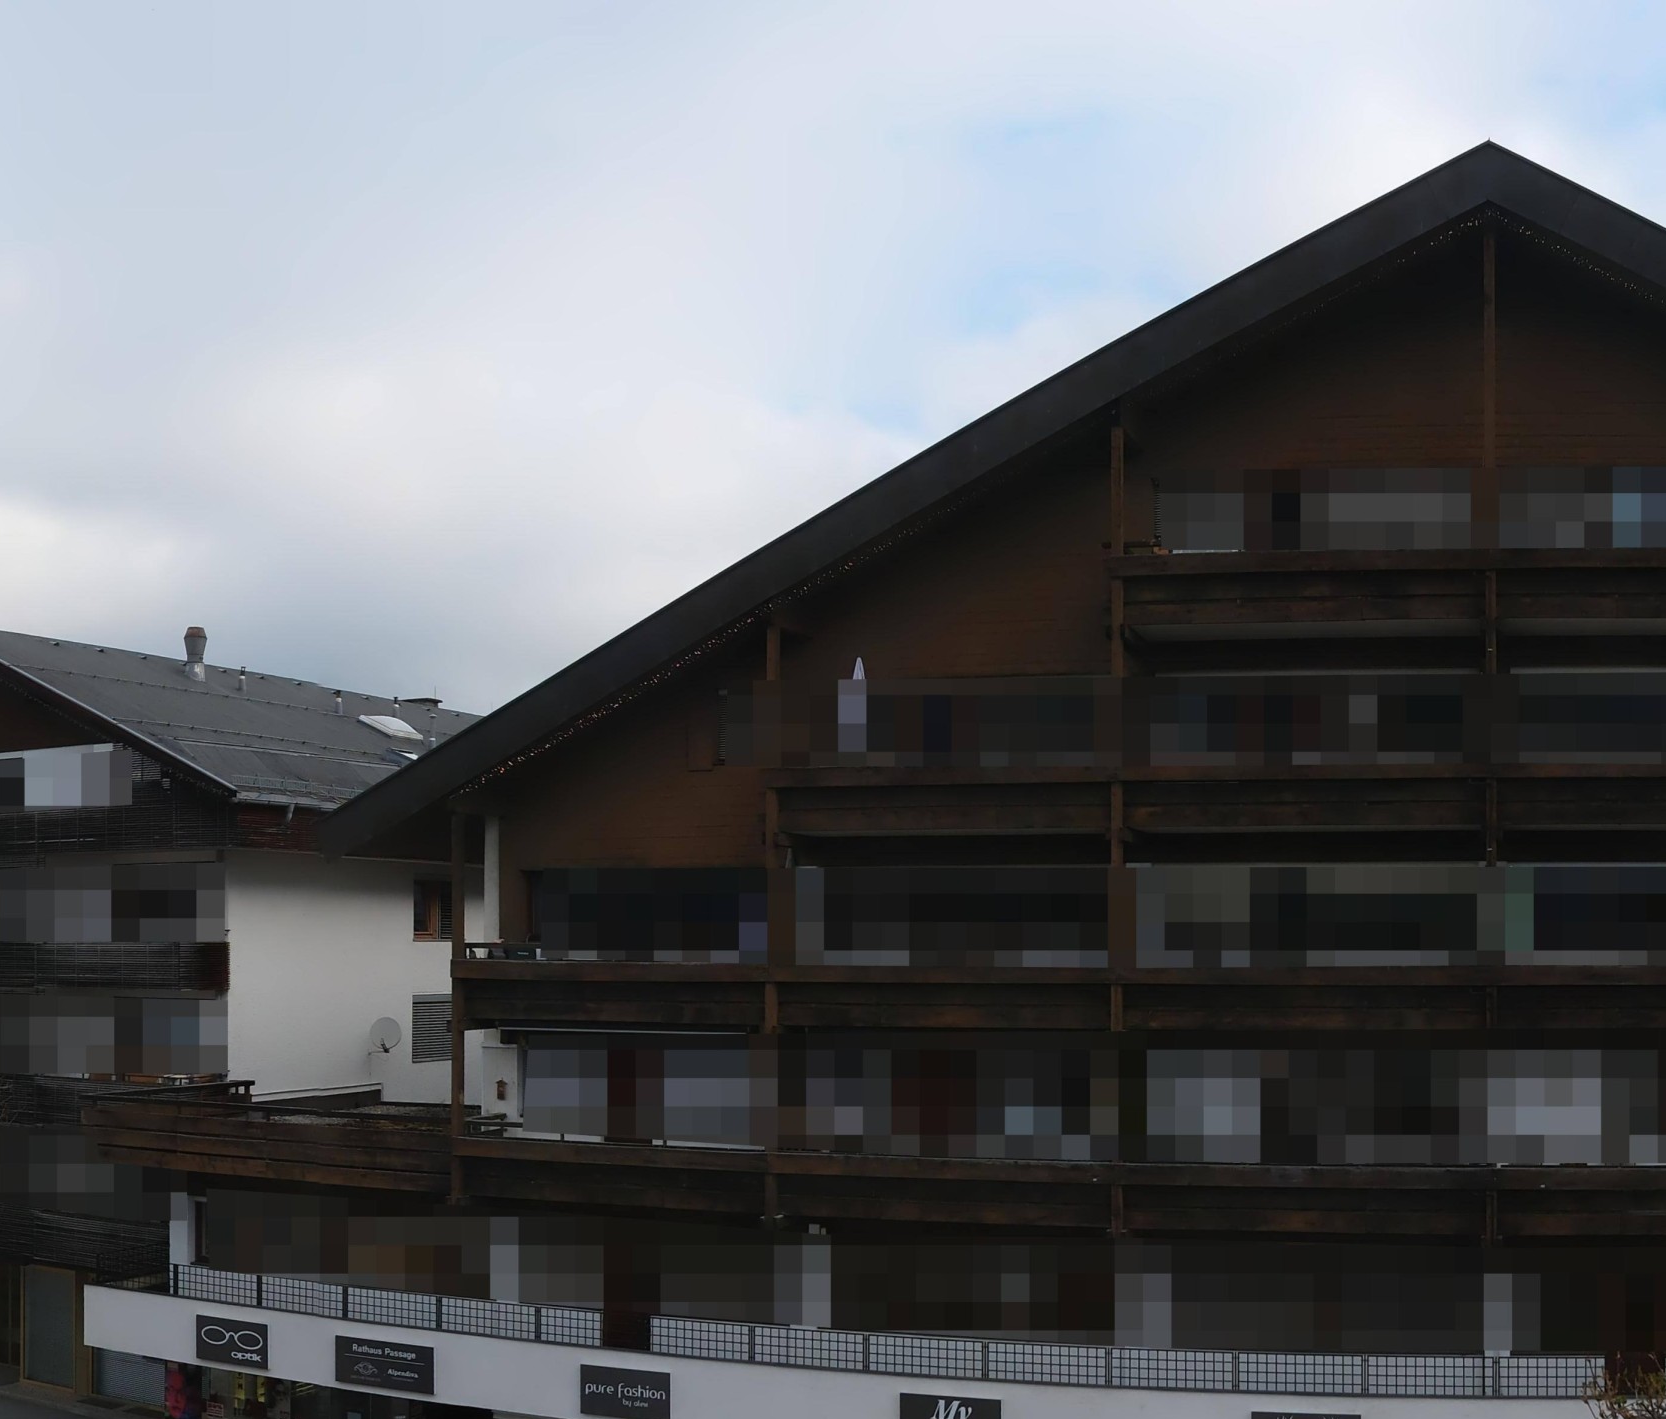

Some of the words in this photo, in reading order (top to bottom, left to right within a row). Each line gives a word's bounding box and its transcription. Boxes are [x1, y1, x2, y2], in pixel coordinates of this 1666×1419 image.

[352, 1343, 382, 1355] Rathaus
[384, 1347, 417, 1360] Passage
[585, 1383, 615, 1395] pure
[617, 1382, 666, 1400] fashion
